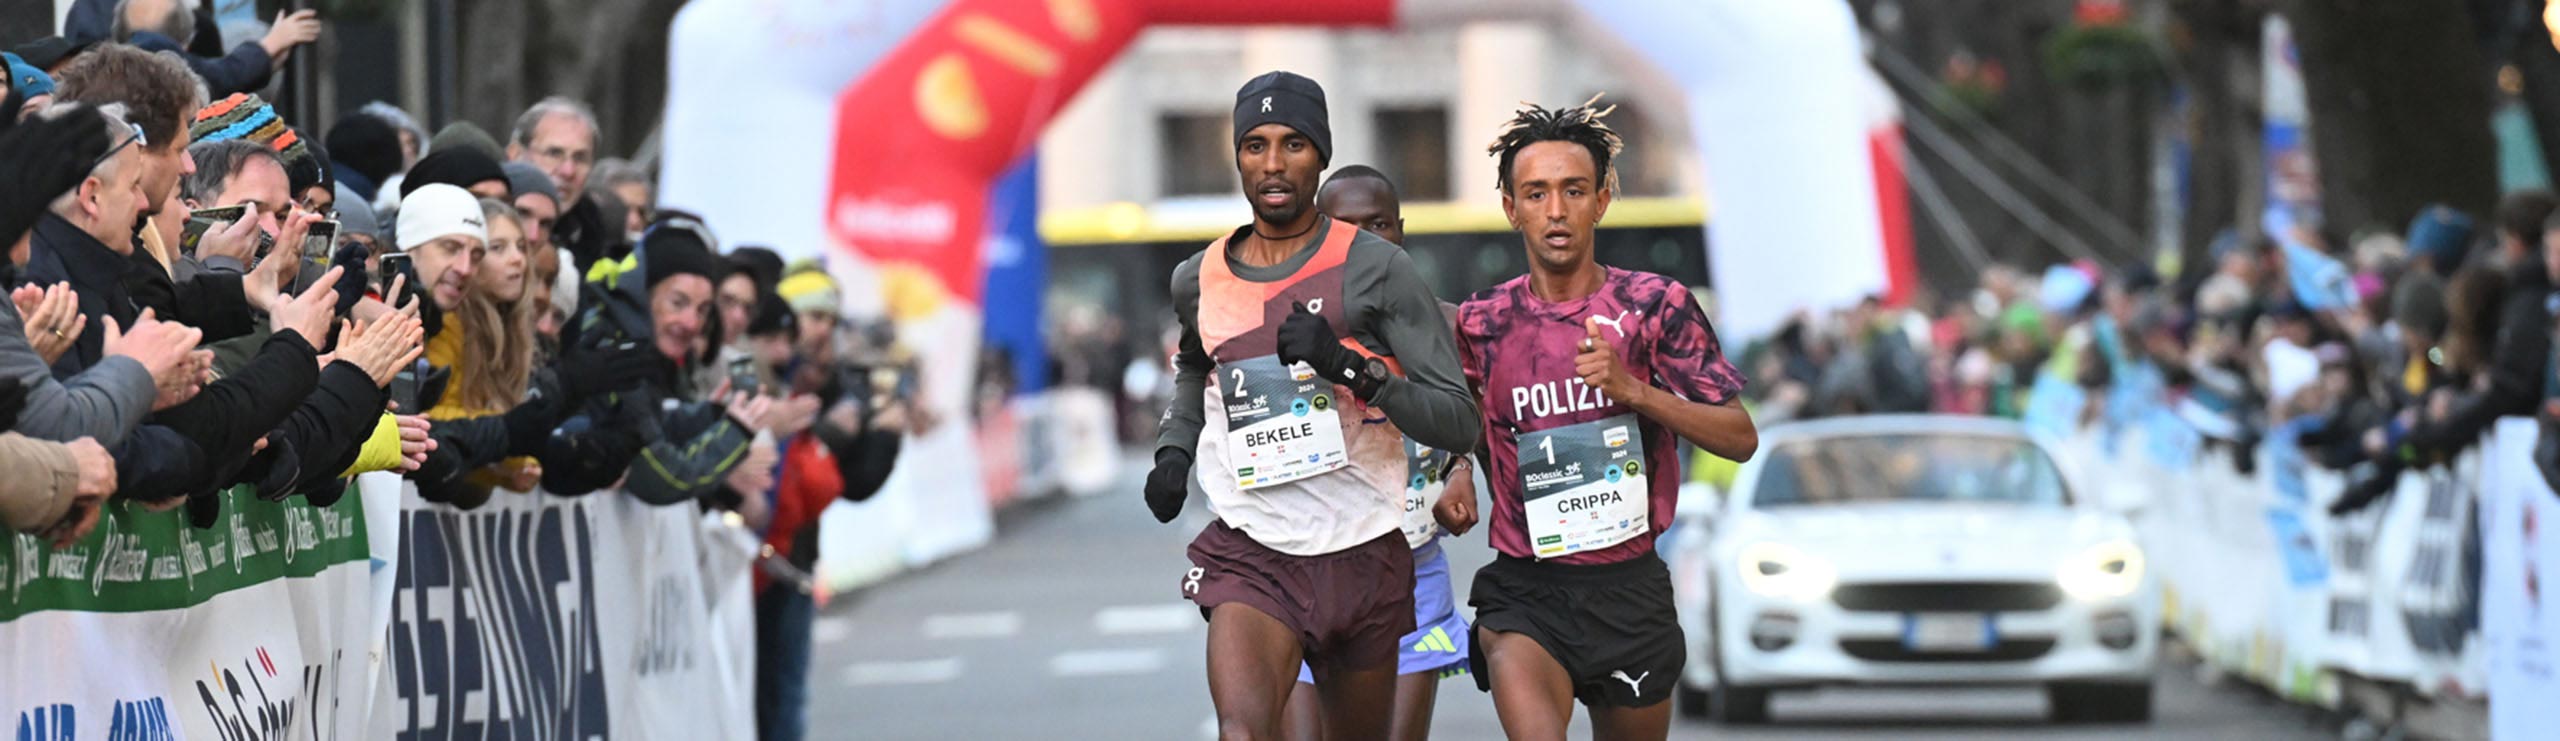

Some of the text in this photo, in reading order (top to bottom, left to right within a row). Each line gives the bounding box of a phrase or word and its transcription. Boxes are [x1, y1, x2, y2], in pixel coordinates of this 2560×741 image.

[1231, 368, 1248, 398] 2
[1512, 377, 1613, 421] POLIZI
[1245, 422, 1314, 447] BEKELE
[1538, 434, 1556, 465] 1
[1405, 496, 1424, 512] CH
[1557, 490, 1623, 513] CRIPPA
[386, 502, 610, 741] SSELUNGA
